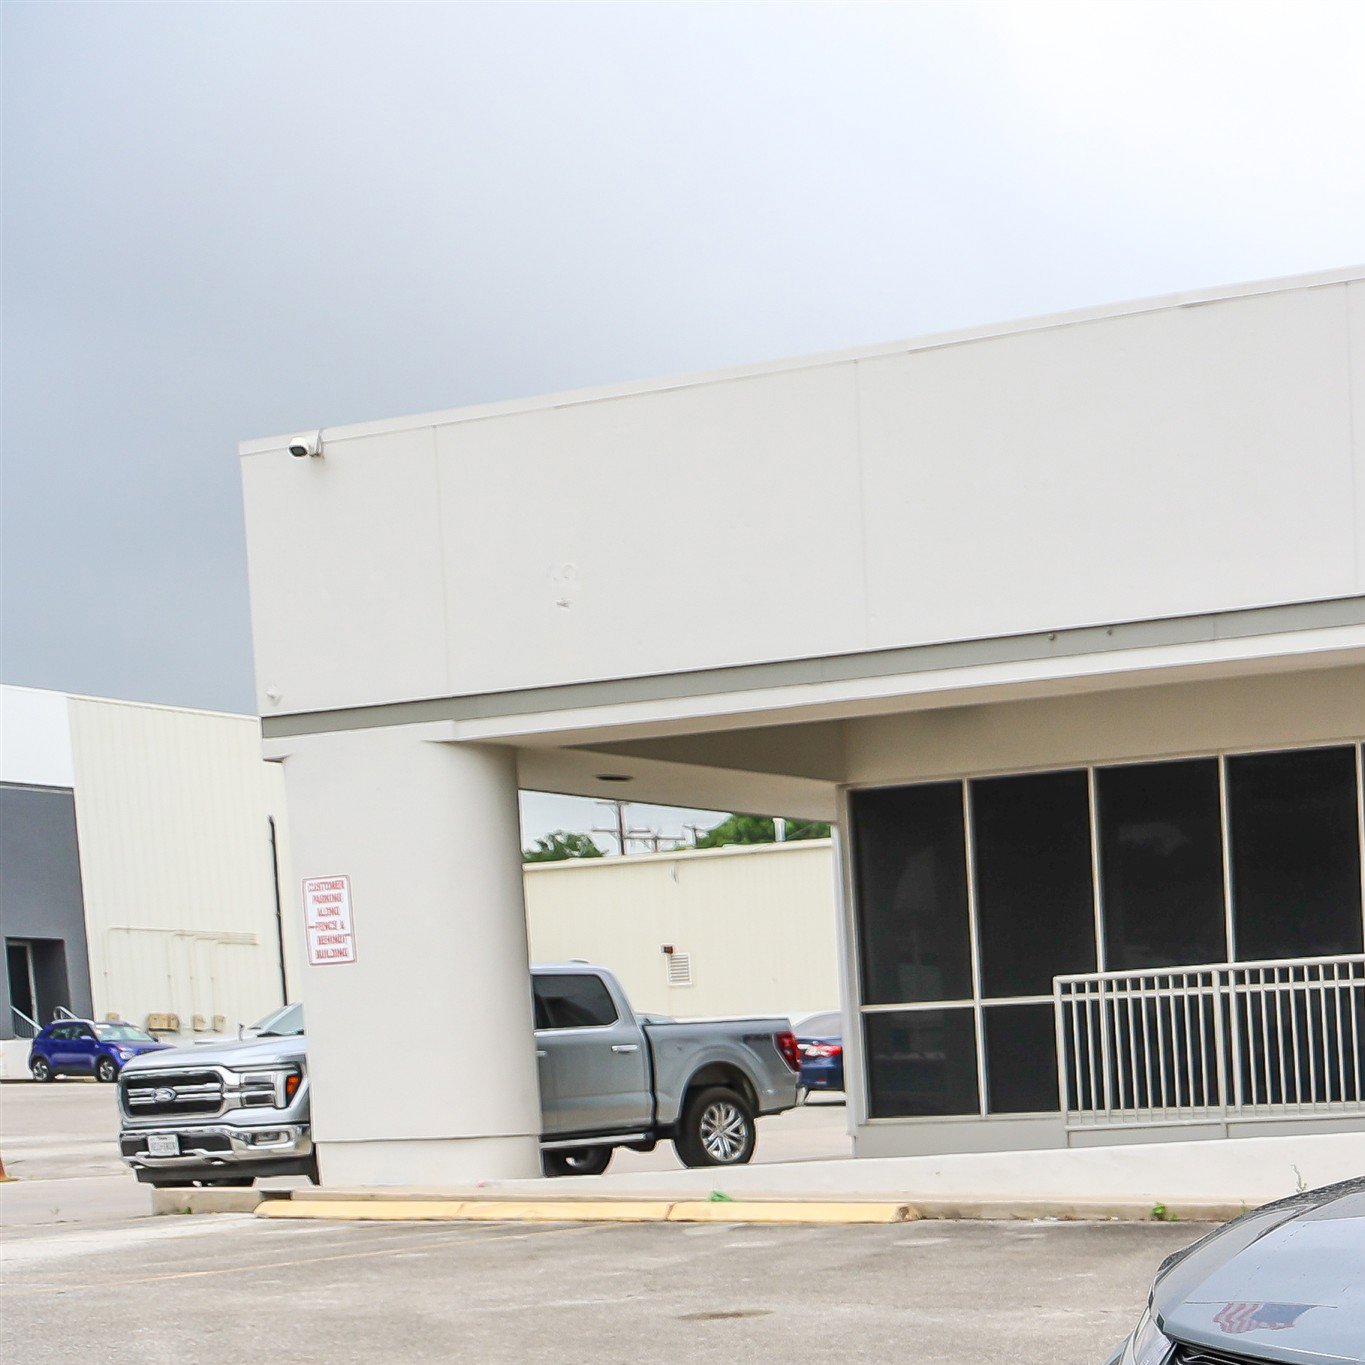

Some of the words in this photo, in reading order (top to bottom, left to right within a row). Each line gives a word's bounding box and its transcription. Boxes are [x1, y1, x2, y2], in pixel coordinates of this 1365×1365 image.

[308, 880, 345, 892] CUSTOMER
[312, 893, 343, 905] PARKING
[315, 947, 348, 959] BUILDING
